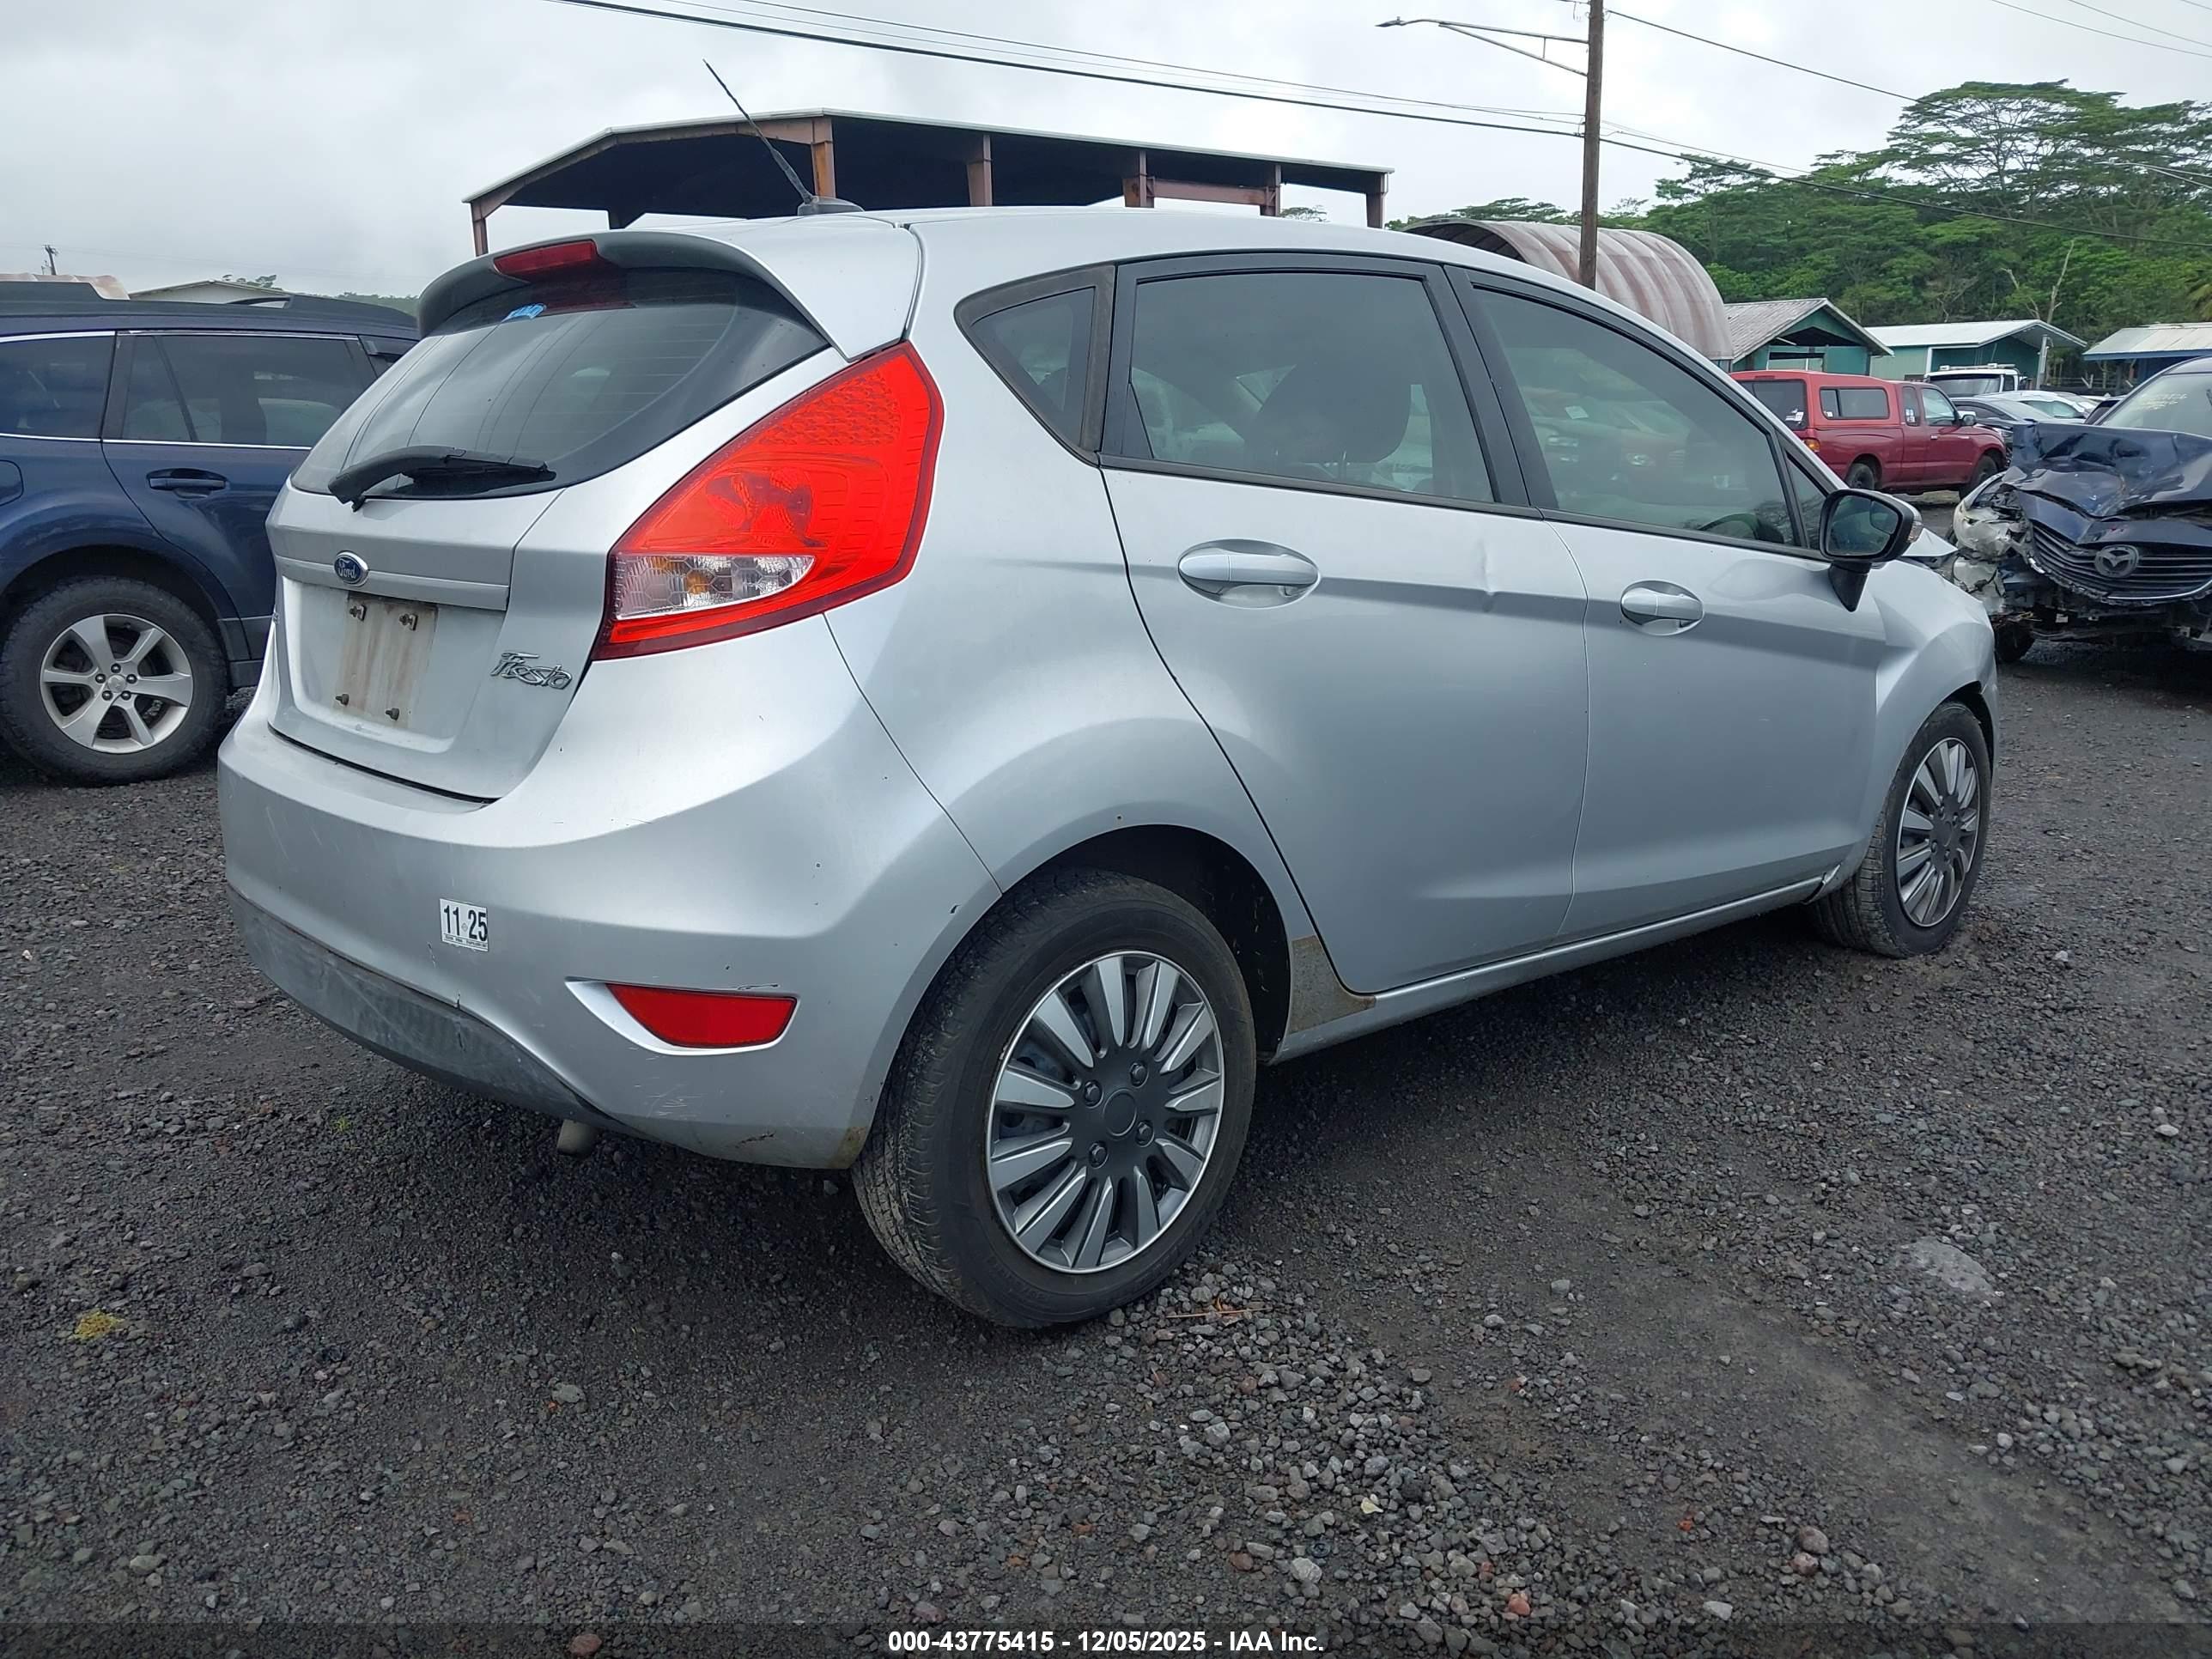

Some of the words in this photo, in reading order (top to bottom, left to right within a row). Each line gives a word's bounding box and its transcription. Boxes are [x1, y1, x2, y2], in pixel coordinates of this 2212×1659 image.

[337, 558, 357, 579] Ford
[490, 652, 573, 690] Fiesta
[443, 904, 460, 936] 11
[468, 909, 489, 942] 25
